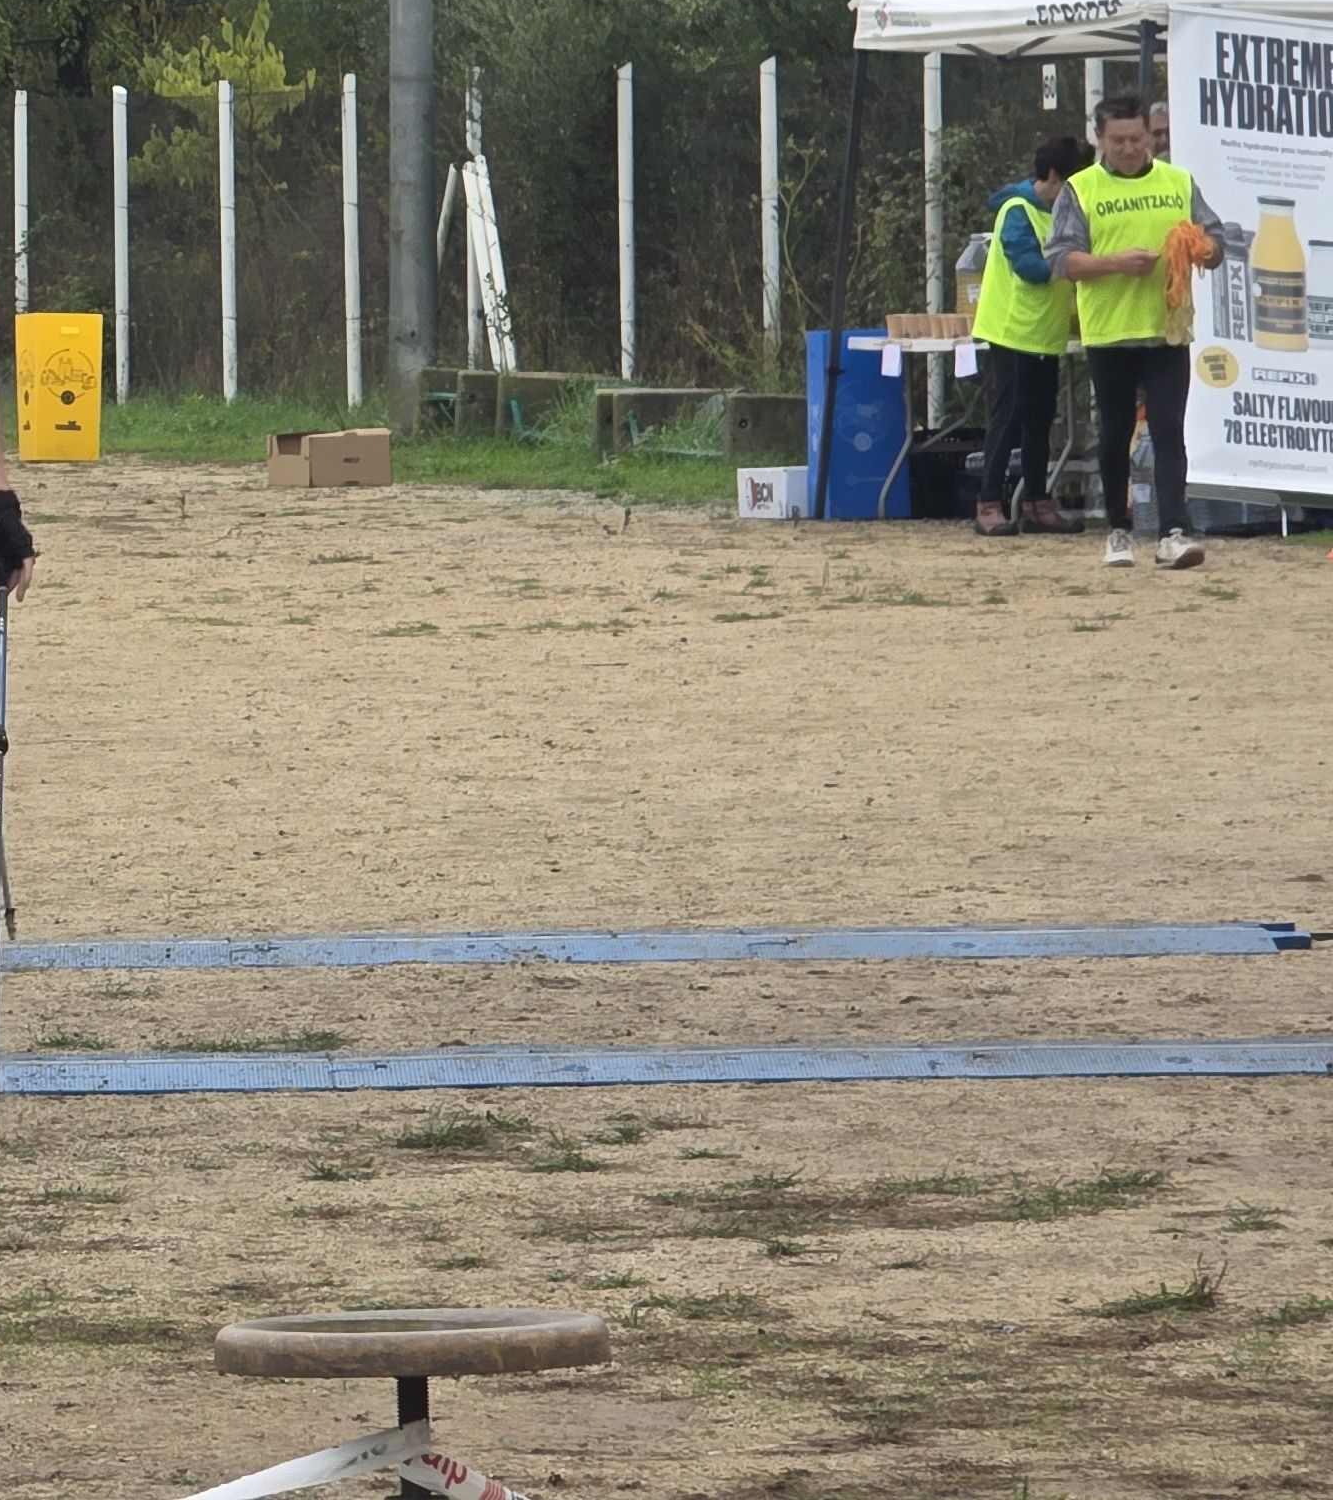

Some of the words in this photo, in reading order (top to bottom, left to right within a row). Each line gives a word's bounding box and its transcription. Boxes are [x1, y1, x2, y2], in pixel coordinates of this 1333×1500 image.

[1216, 31, 1333, 90] EXTREME
[1096, 191, 1184, 217] ORGANITZACIÓ
[1230, 264, 1247, 341] REFIX
[1252, 368, 1311, 385] REFIX
[1233, 391, 1276, 419] SALTY
[1277, 395, 1333, 425] FLAVOU
[1223, 418, 1242, 445] 78
